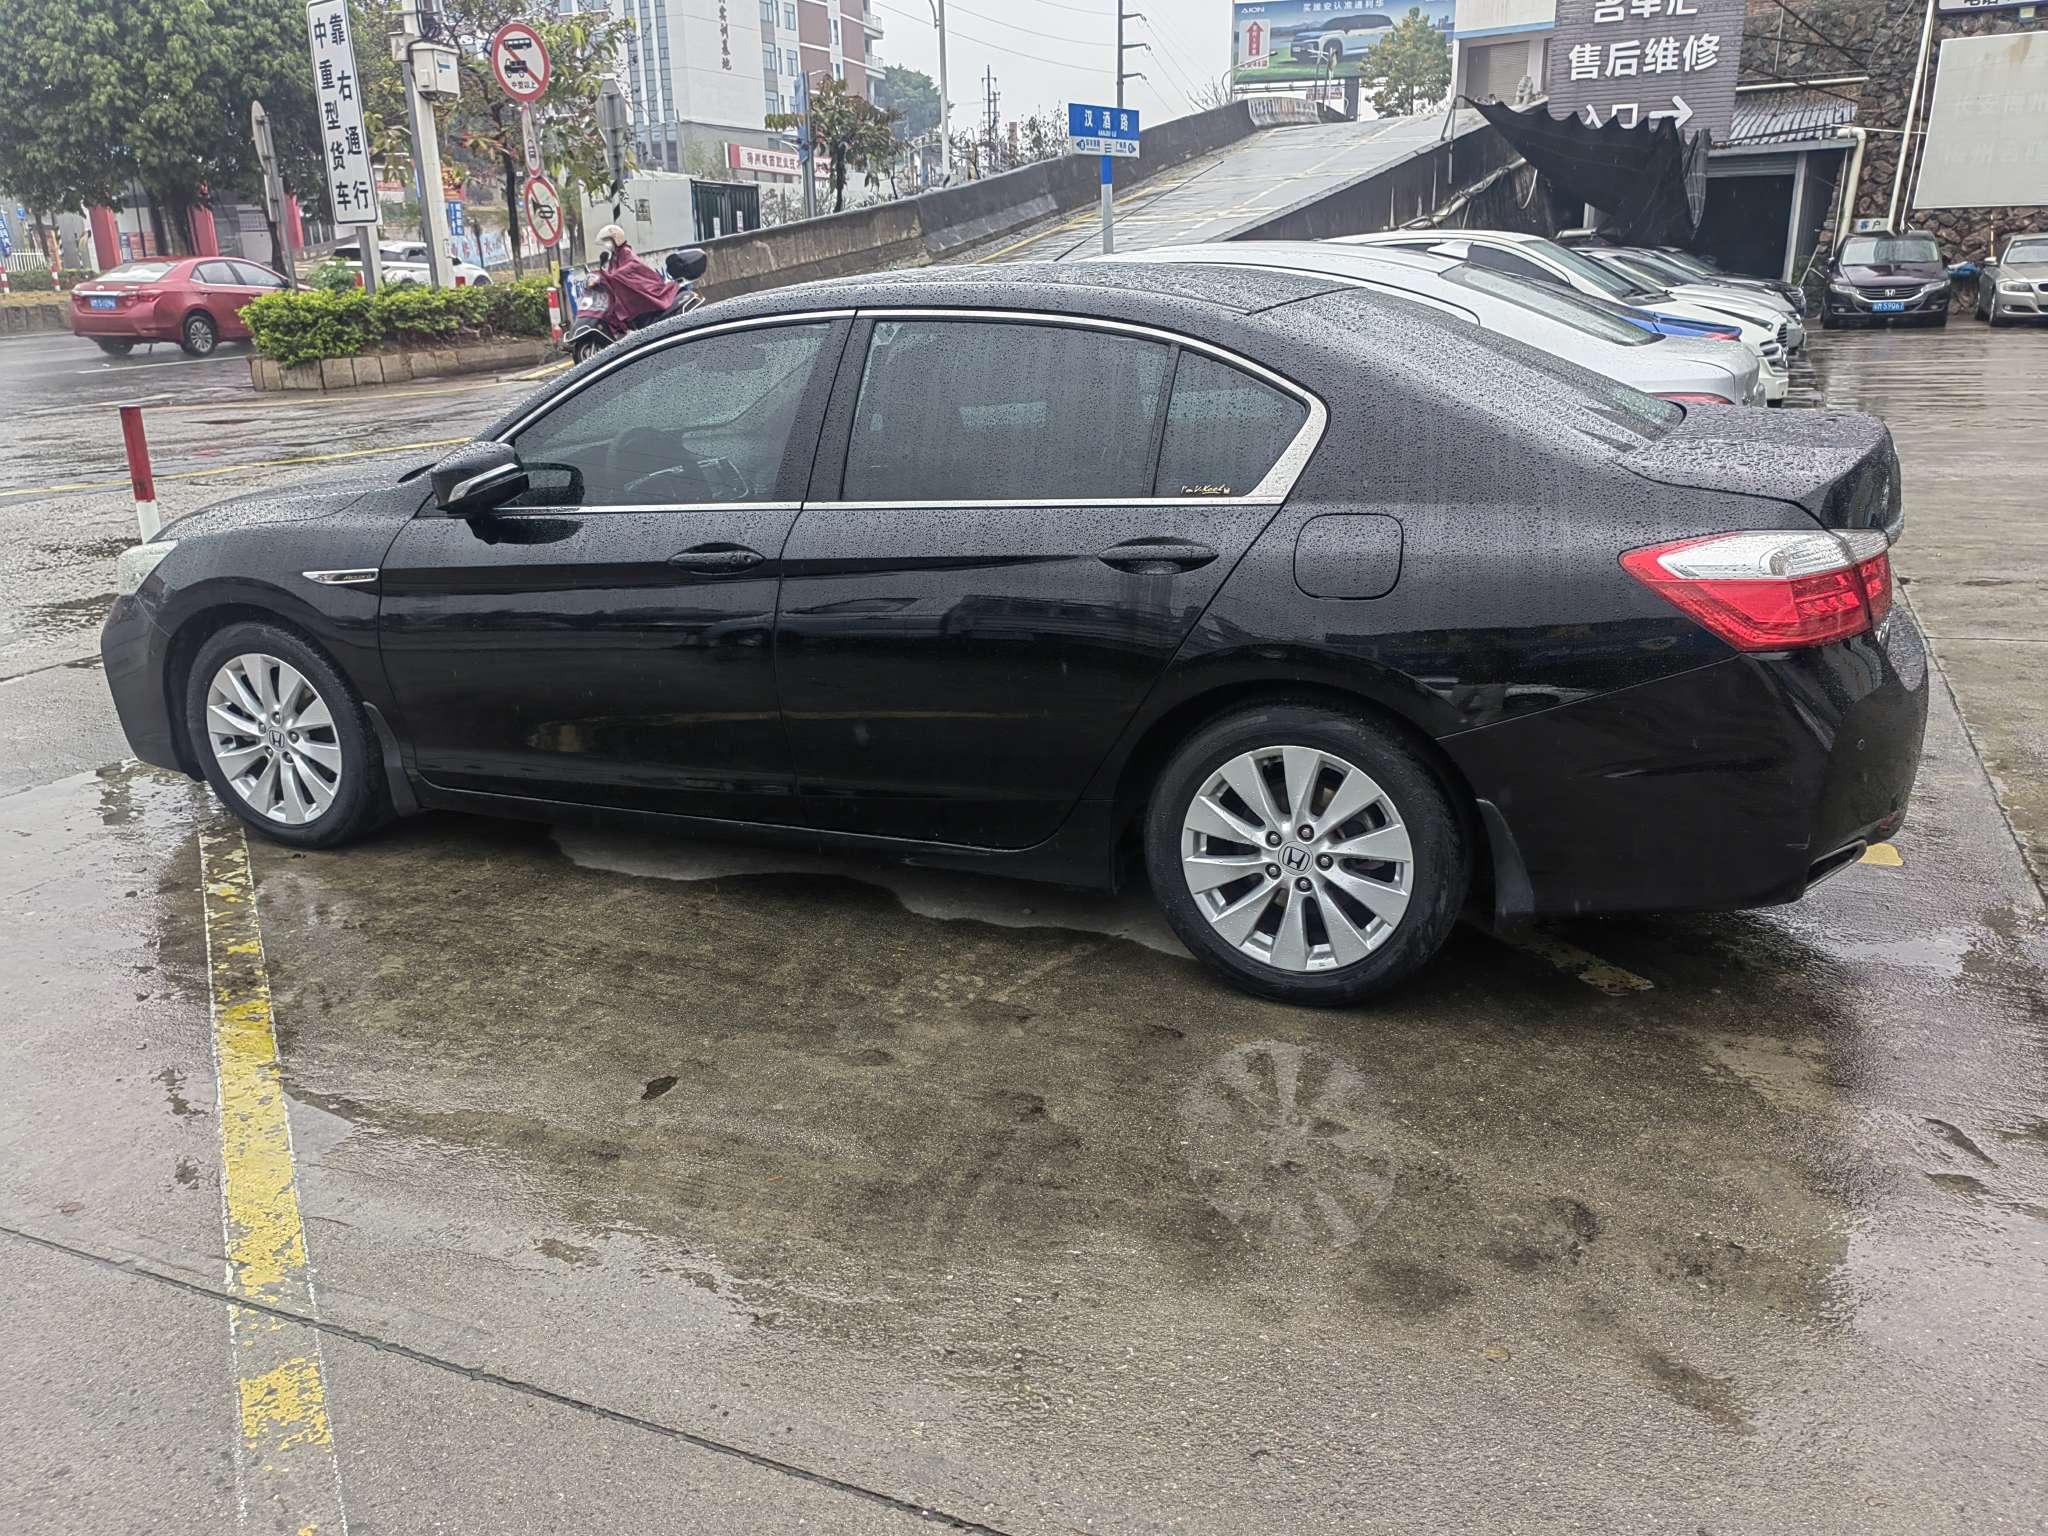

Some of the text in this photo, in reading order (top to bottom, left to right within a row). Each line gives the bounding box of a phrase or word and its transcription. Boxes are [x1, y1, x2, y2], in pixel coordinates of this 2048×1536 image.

[719, 0, 732, 70] 实训基地
[1569, 33, 1720, 81] 售后维修
[314, 17, 351, 211] 中重型货车
[329, 13, 369, 210] 靠右通行
